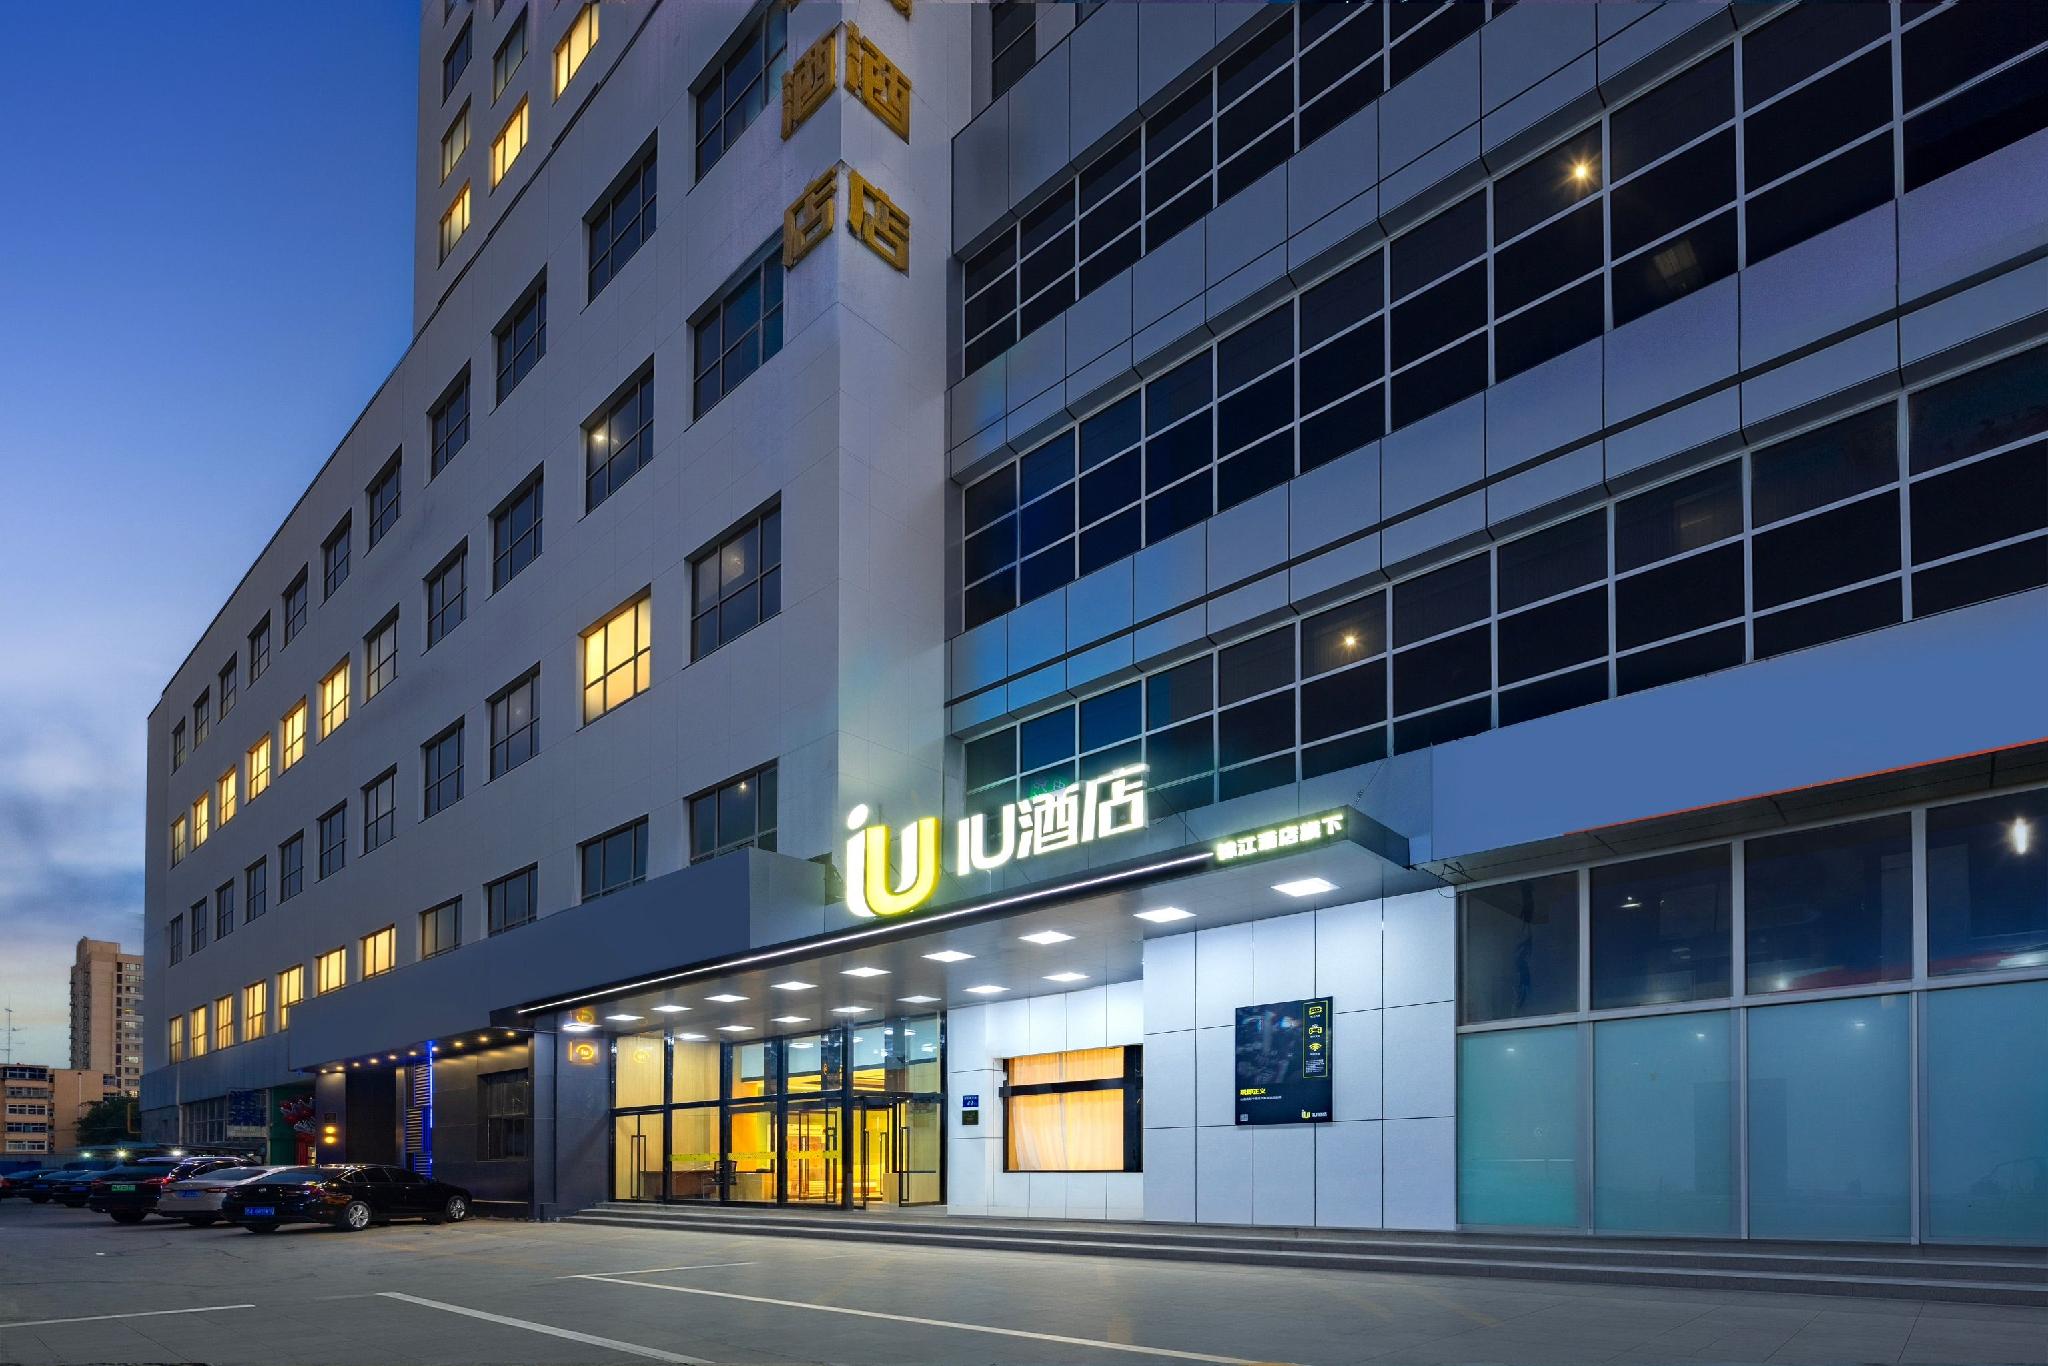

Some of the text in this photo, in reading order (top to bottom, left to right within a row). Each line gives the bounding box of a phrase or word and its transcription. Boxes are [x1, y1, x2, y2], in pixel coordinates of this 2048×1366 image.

[781, 0, 838, 270] 酒店
[844, 0, 912, 274] 酒店
[957, 763, 1150, 877] IU酒店
